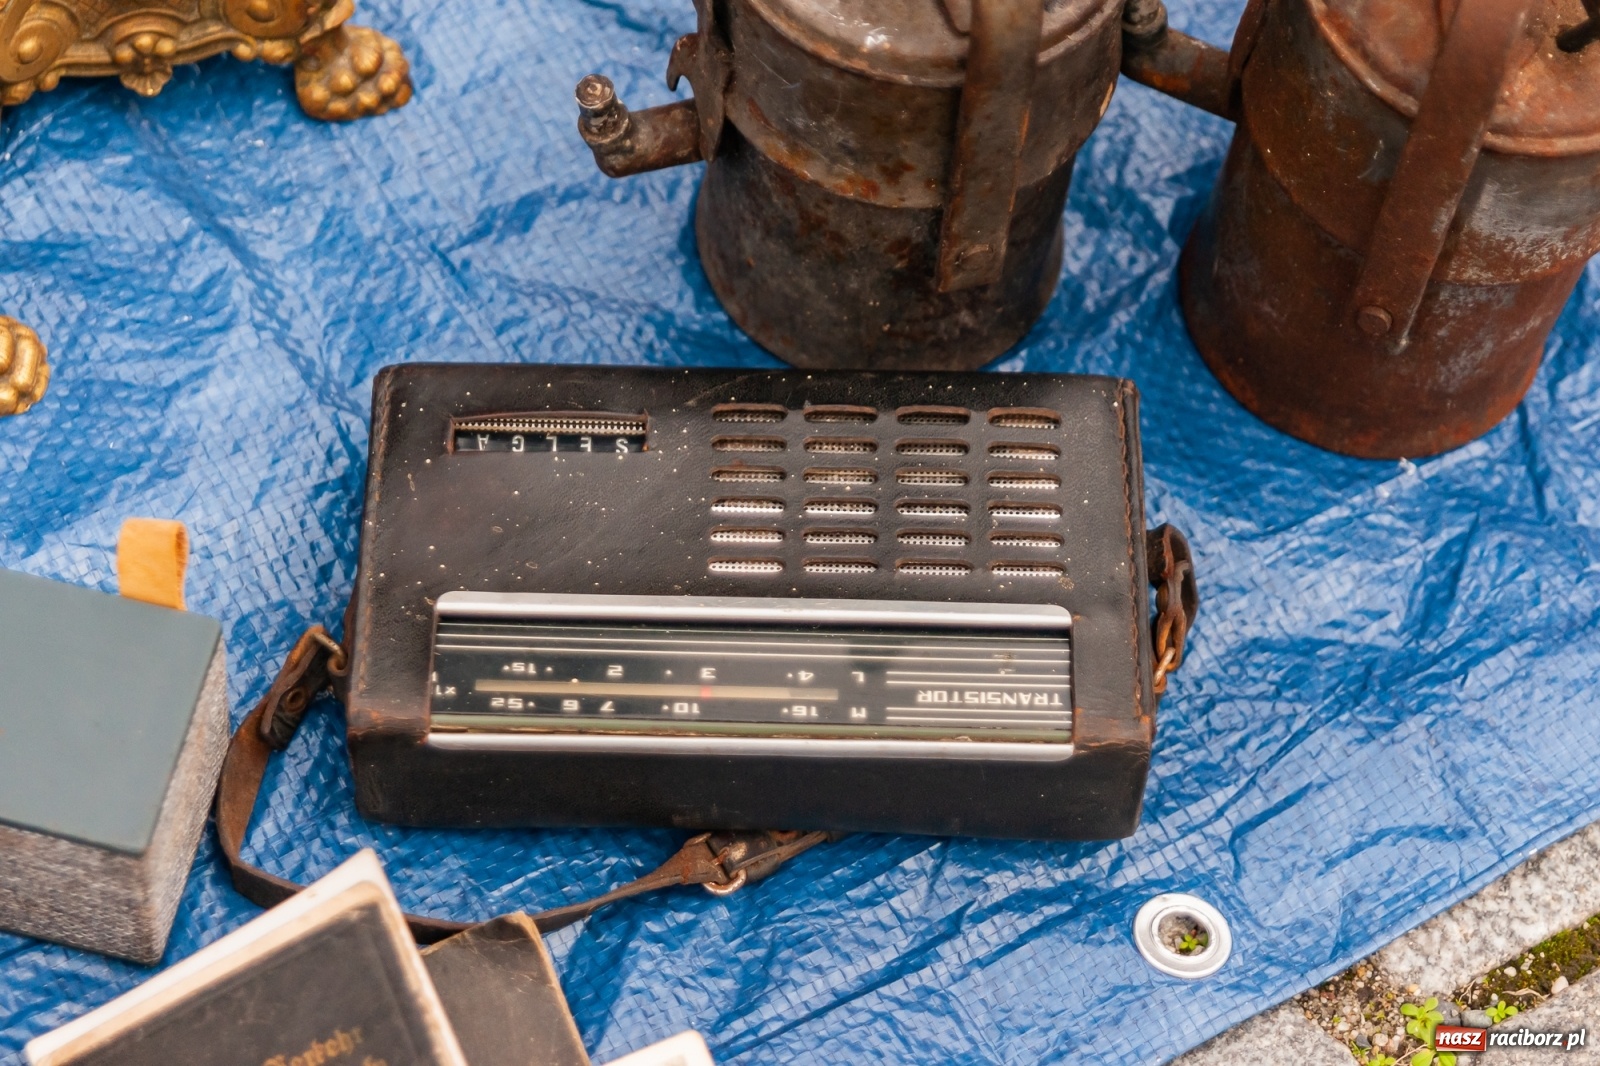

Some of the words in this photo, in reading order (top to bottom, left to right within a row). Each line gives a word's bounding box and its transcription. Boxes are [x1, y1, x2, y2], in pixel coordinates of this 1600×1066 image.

[477, 433, 628, 453] SELGA
[607, 665, 624, 676] 2
[701, 667, 716, 679] 3
[797, 670, 814, 681] 4
[851, 671, 865, 683] L
[917, 690, 1064, 705] TRANSISTOR
[563, 699, 579, 711] 6
[600, 701, 615, 712] 7
[673, 702, 700, 714] 10
[792, 705, 818, 717] 16
[851, 707, 866, 718] M
